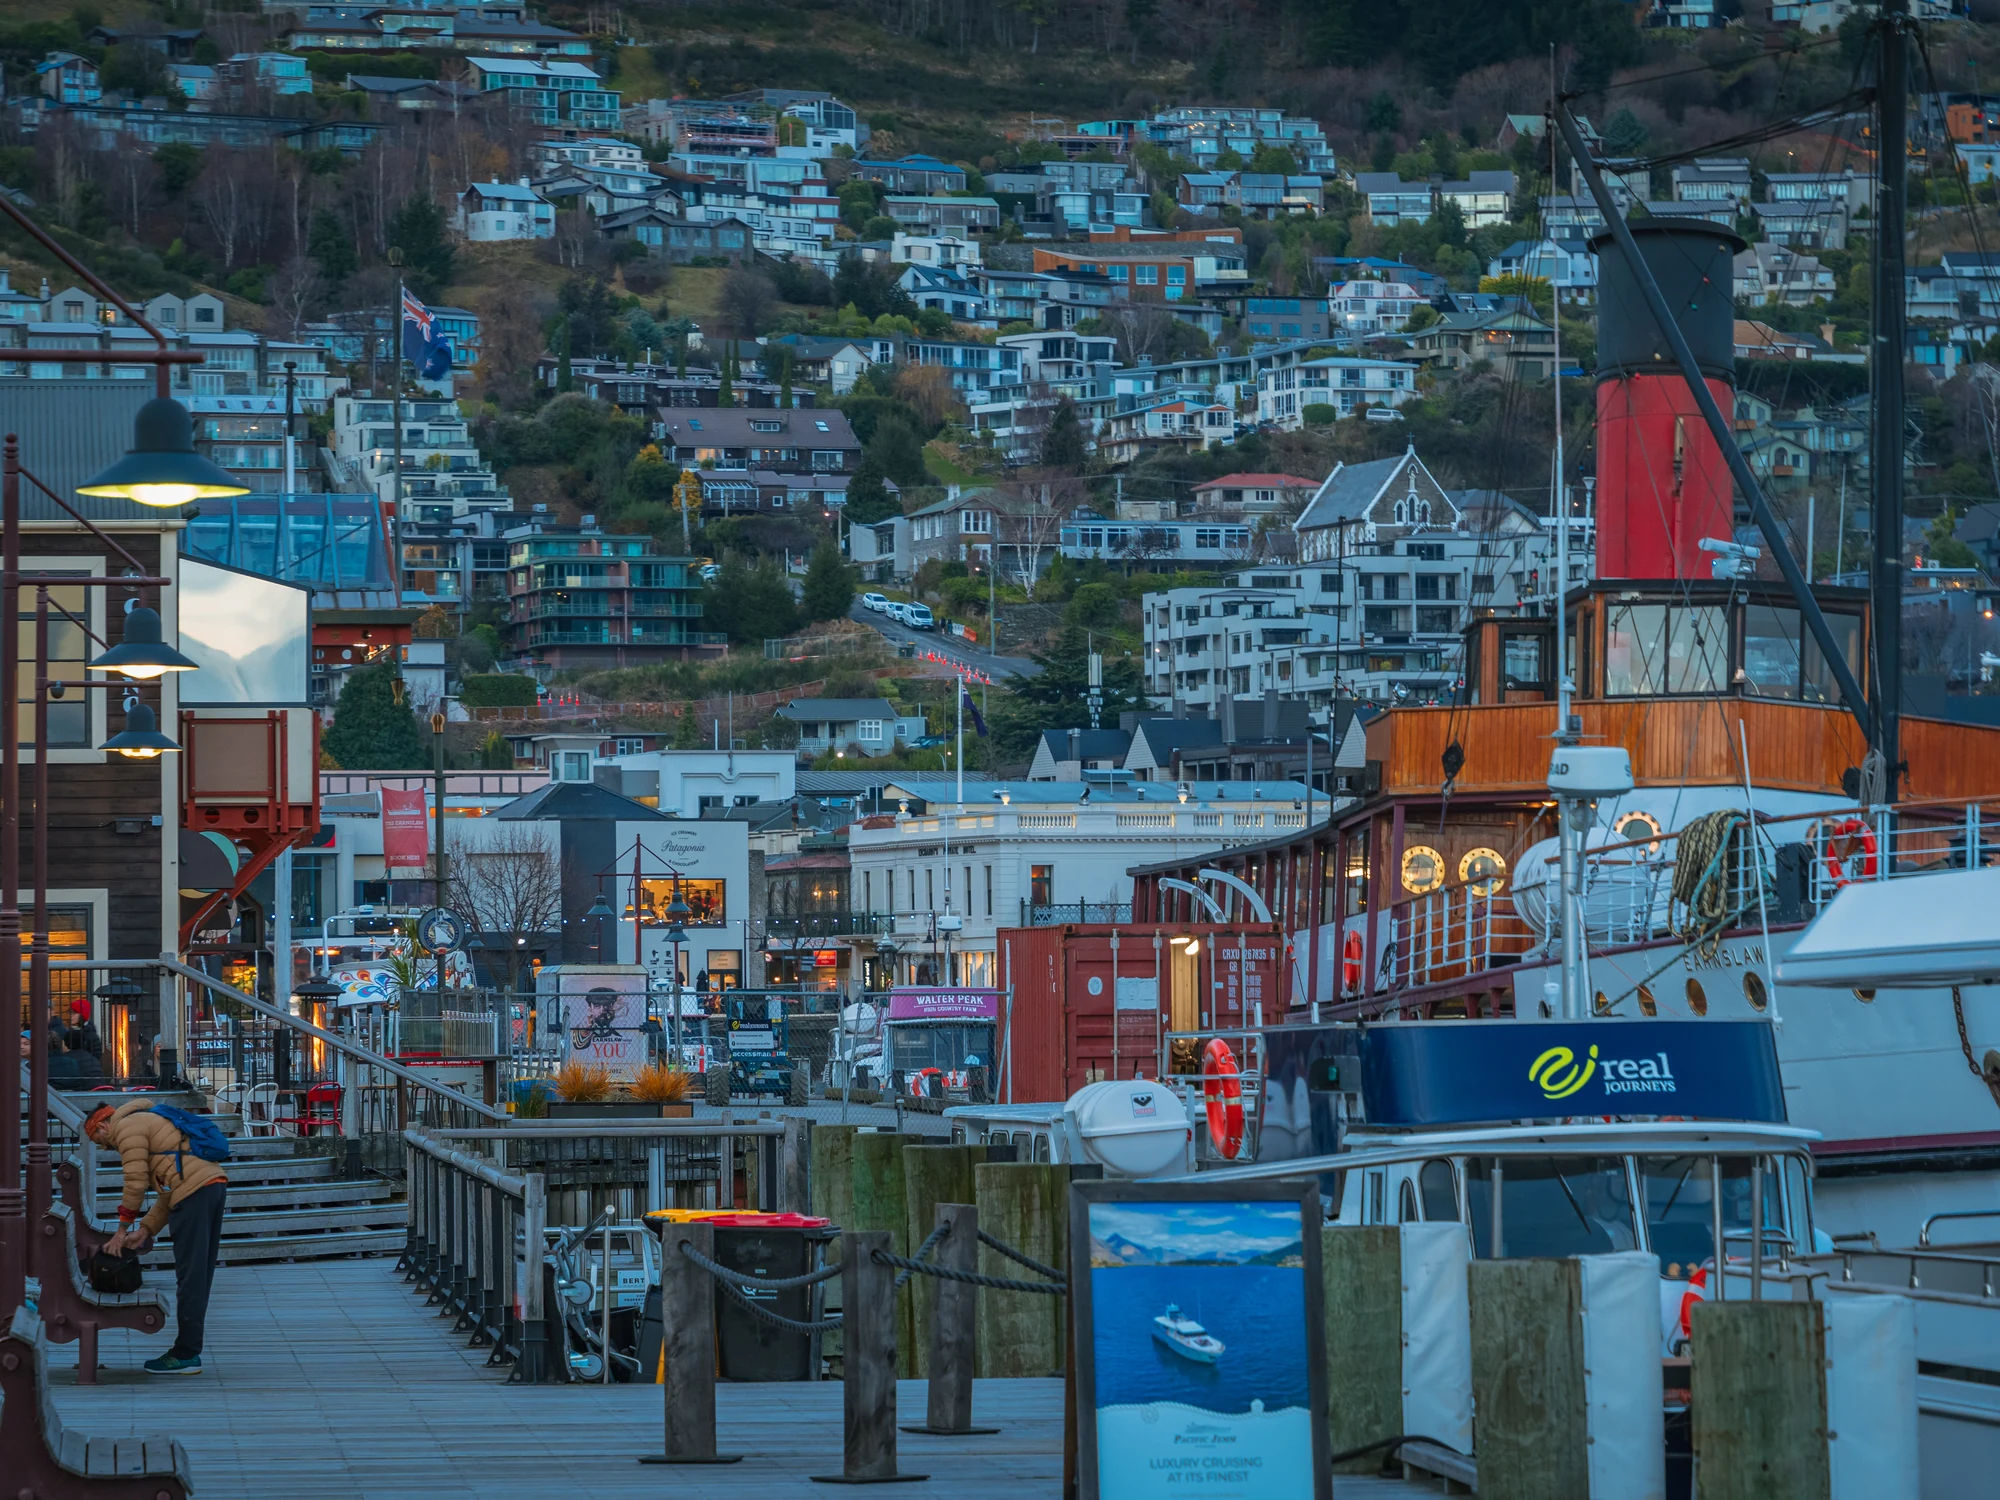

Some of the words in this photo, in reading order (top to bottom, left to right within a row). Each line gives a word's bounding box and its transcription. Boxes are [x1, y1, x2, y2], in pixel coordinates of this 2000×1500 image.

[661, 839, 706, 856] Patagonia
[1222, 948, 1240, 960] CRXU
[916, 995, 955, 1005] WALTER
[957, 995, 984, 1005] PEAK
[592, 1042, 627, 1059] YOU
[1599, 1052, 1674, 1080] real
[1604, 1080, 1677, 1095] JOURNEYS
[1149, 1457, 1200, 1469] LUXURY
[1201, 1456, 1263, 1468] CRUISING
[1166, 1472, 1183, 1483] AT
[1185, 1472, 1204, 1483] ITS
[1206, 1470, 1249, 1482] FINEST
